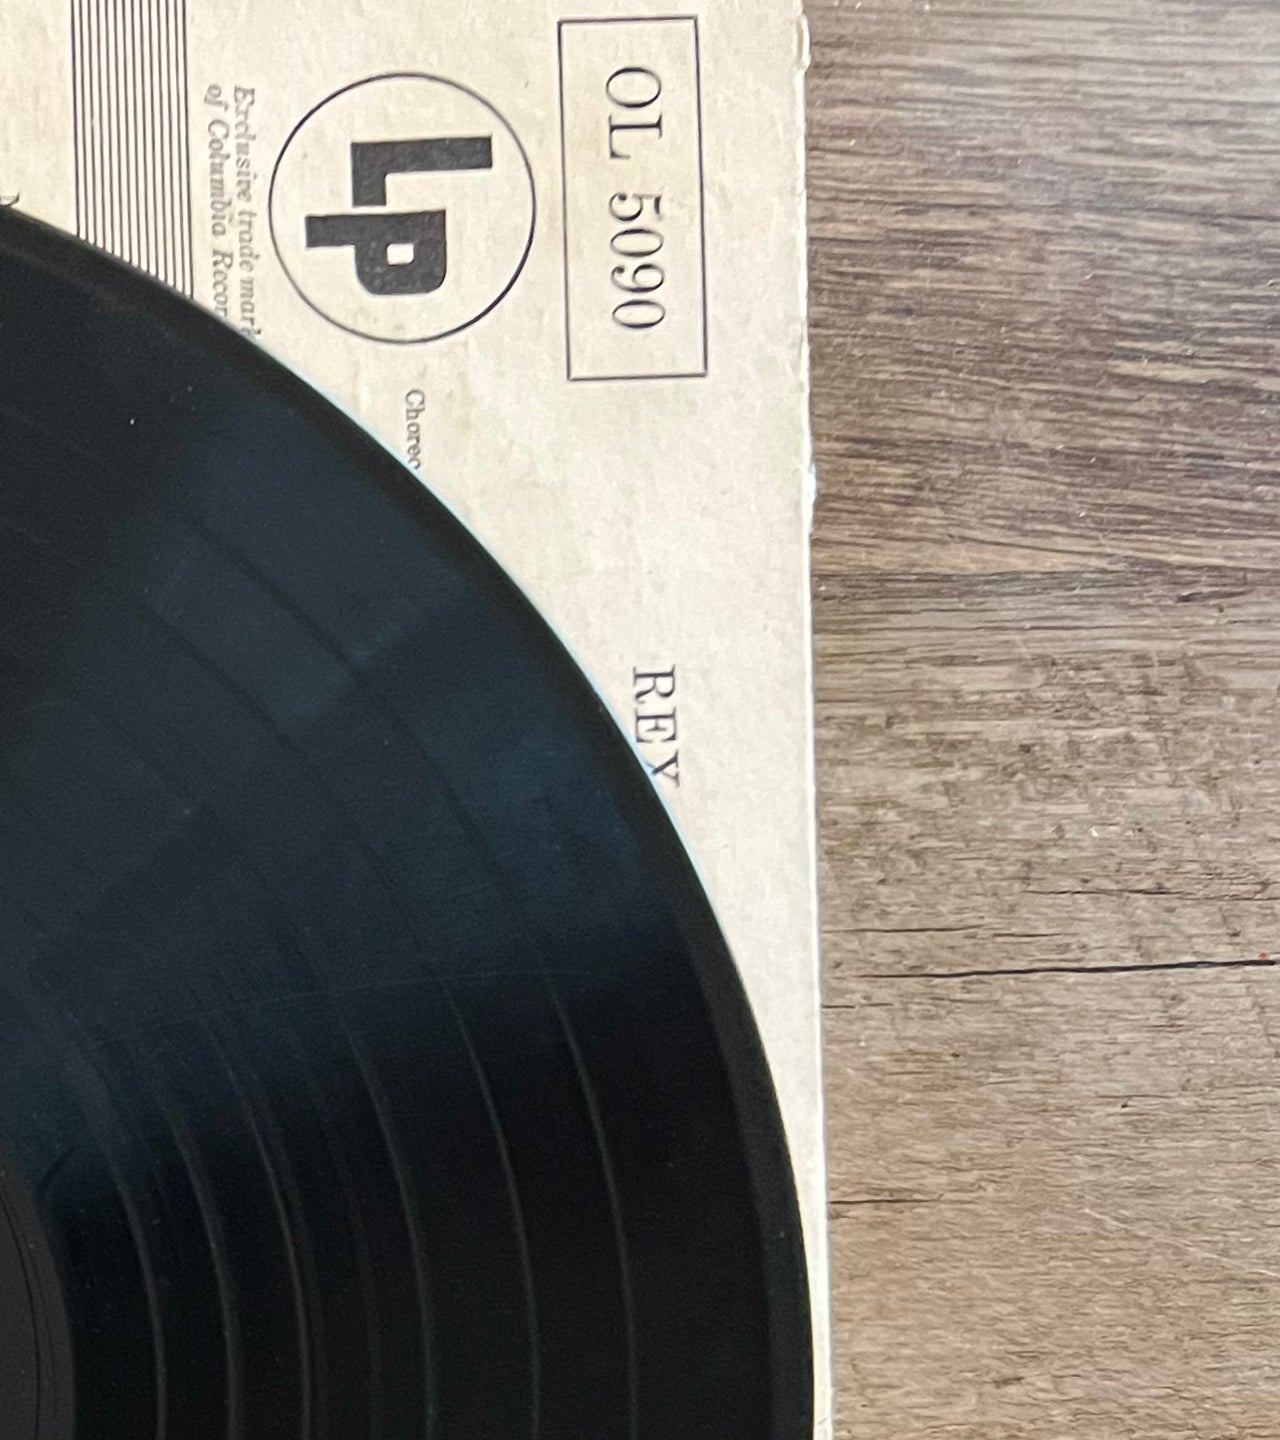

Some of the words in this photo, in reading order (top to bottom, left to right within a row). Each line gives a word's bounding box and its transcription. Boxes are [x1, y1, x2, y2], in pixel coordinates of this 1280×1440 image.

[205, 85, 228, 112] of
[234, 85, 257, 202] Exclusive
[605, 66, 663, 161] OL
[209, 120, 232, 237] Columbia
[237, 211, 260, 272] trade
[609, 192, 667, 331] 5090
